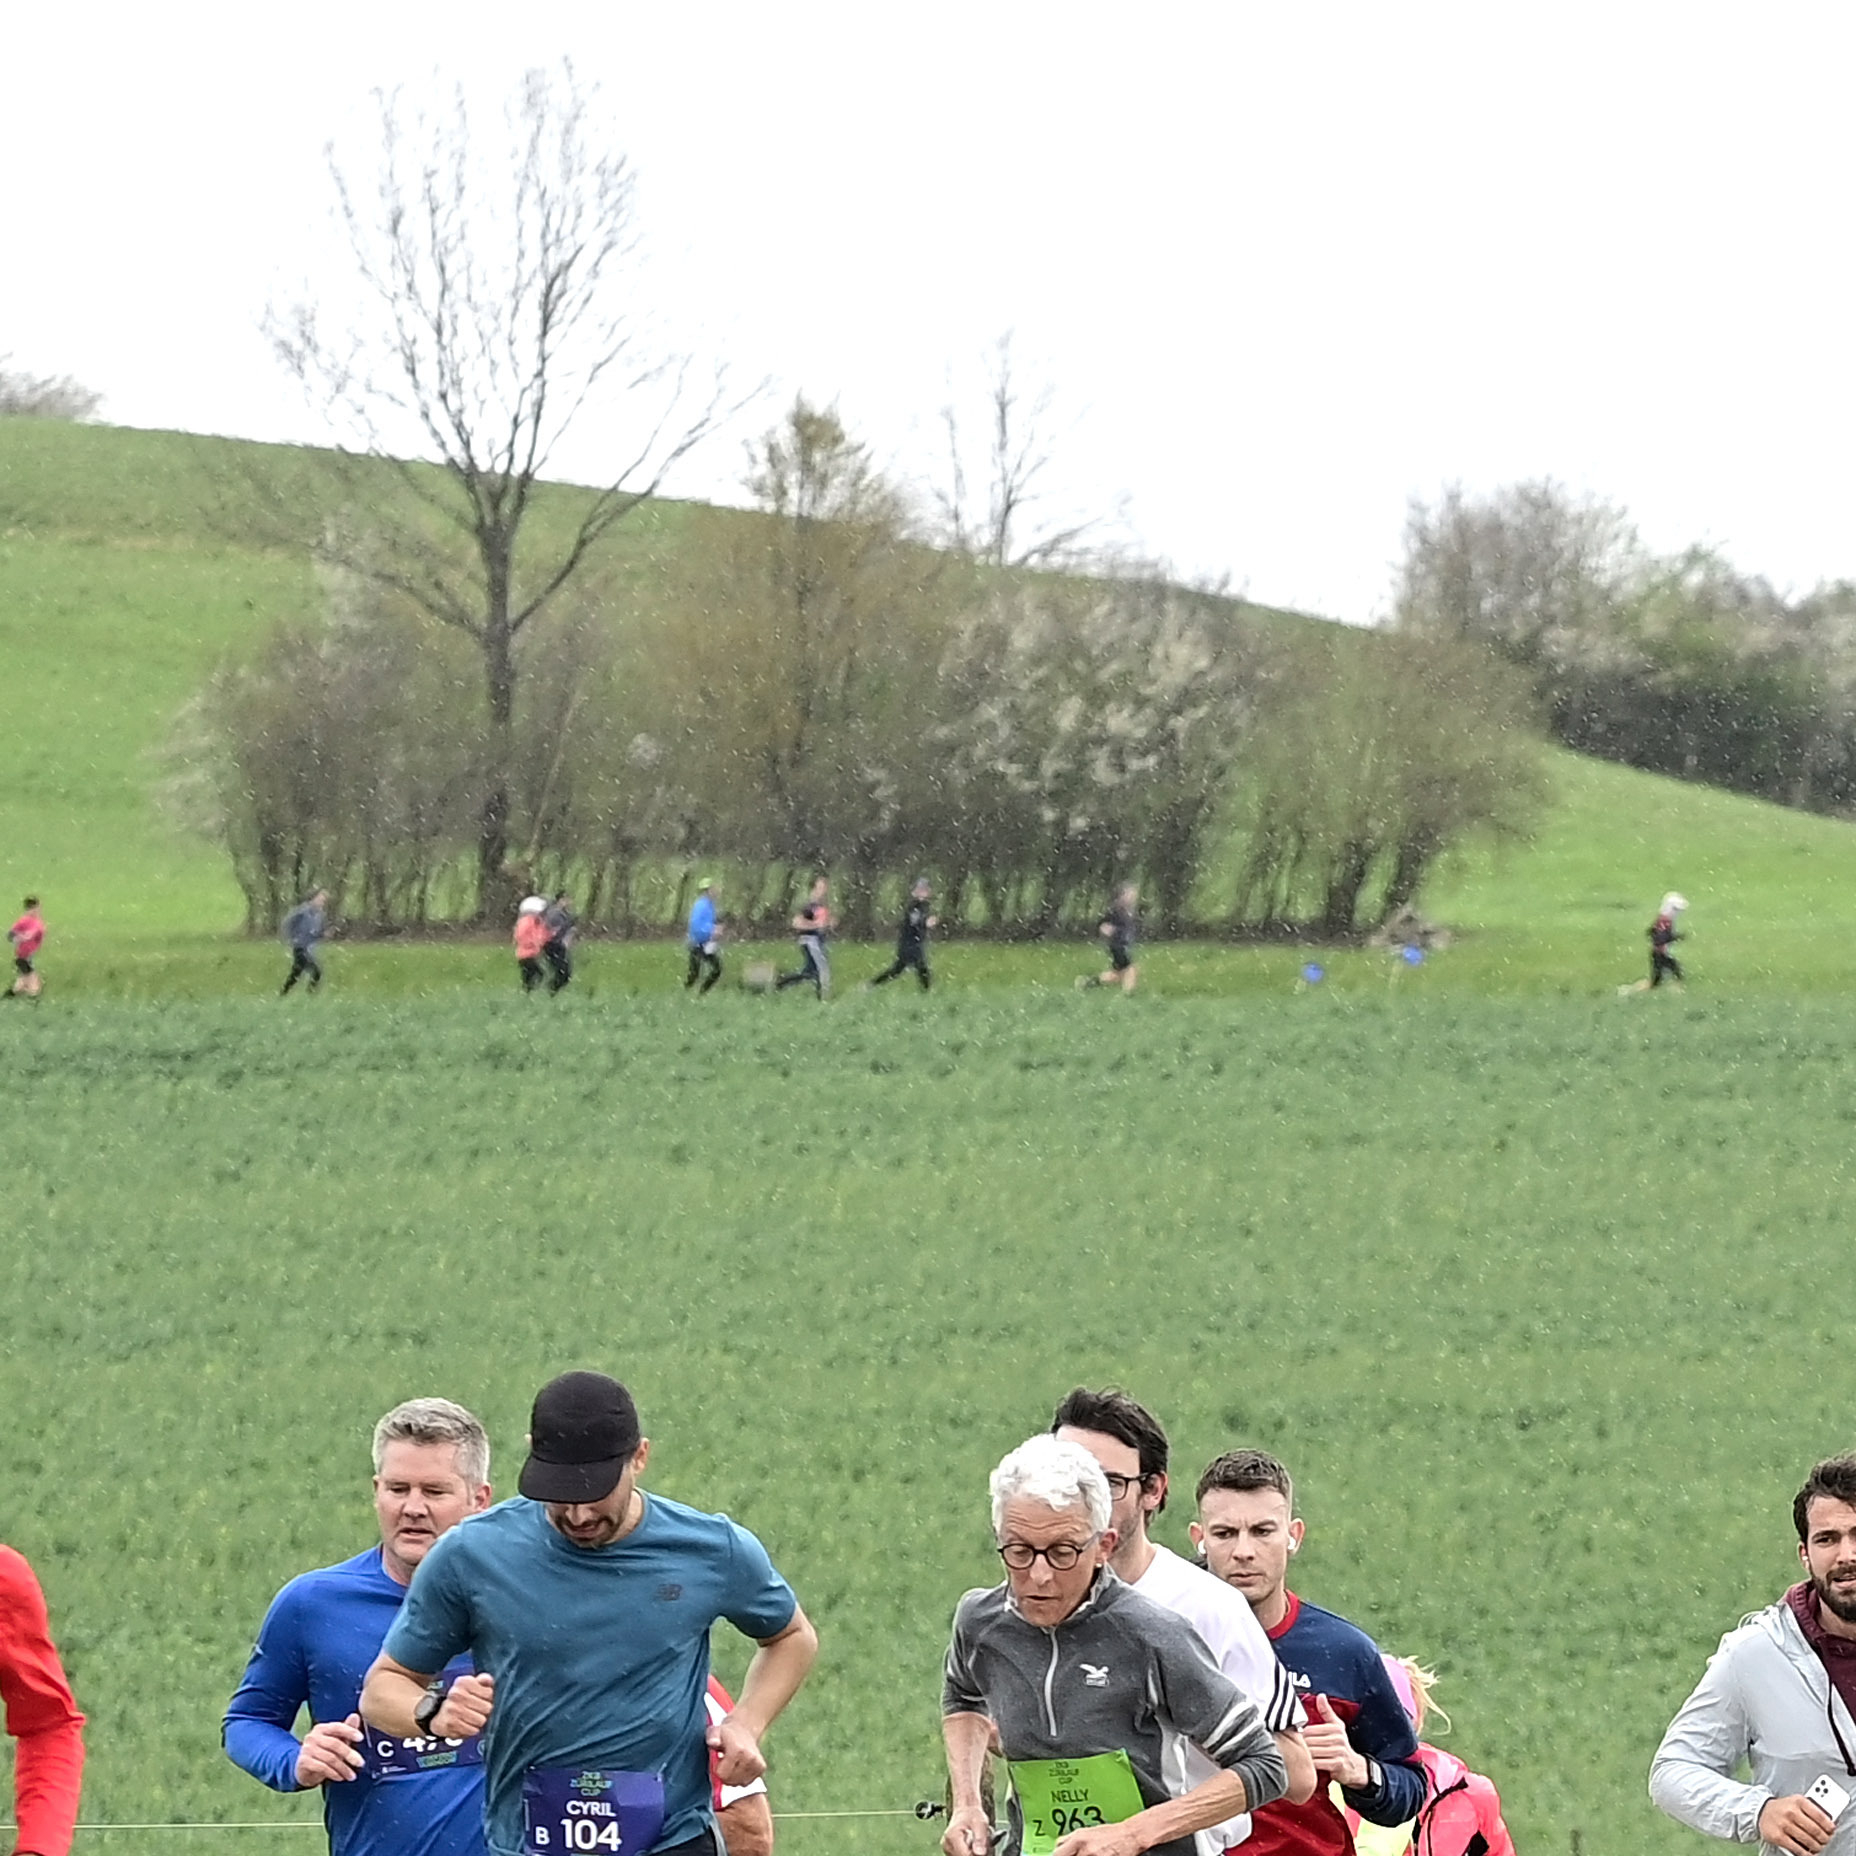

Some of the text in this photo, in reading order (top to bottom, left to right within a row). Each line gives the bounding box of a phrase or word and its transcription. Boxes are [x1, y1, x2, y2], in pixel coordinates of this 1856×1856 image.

[377, 1740, 394, 1757] C
[580, 1788, 601, 1796] CUP
[1050, 1789, 1088, 1802] NELLY
[566, 1800, 617, 1817] CYRIL
[1032, 1806, 1107, 1837] Z 963
[535, 1818, 623, 1852] B 104
